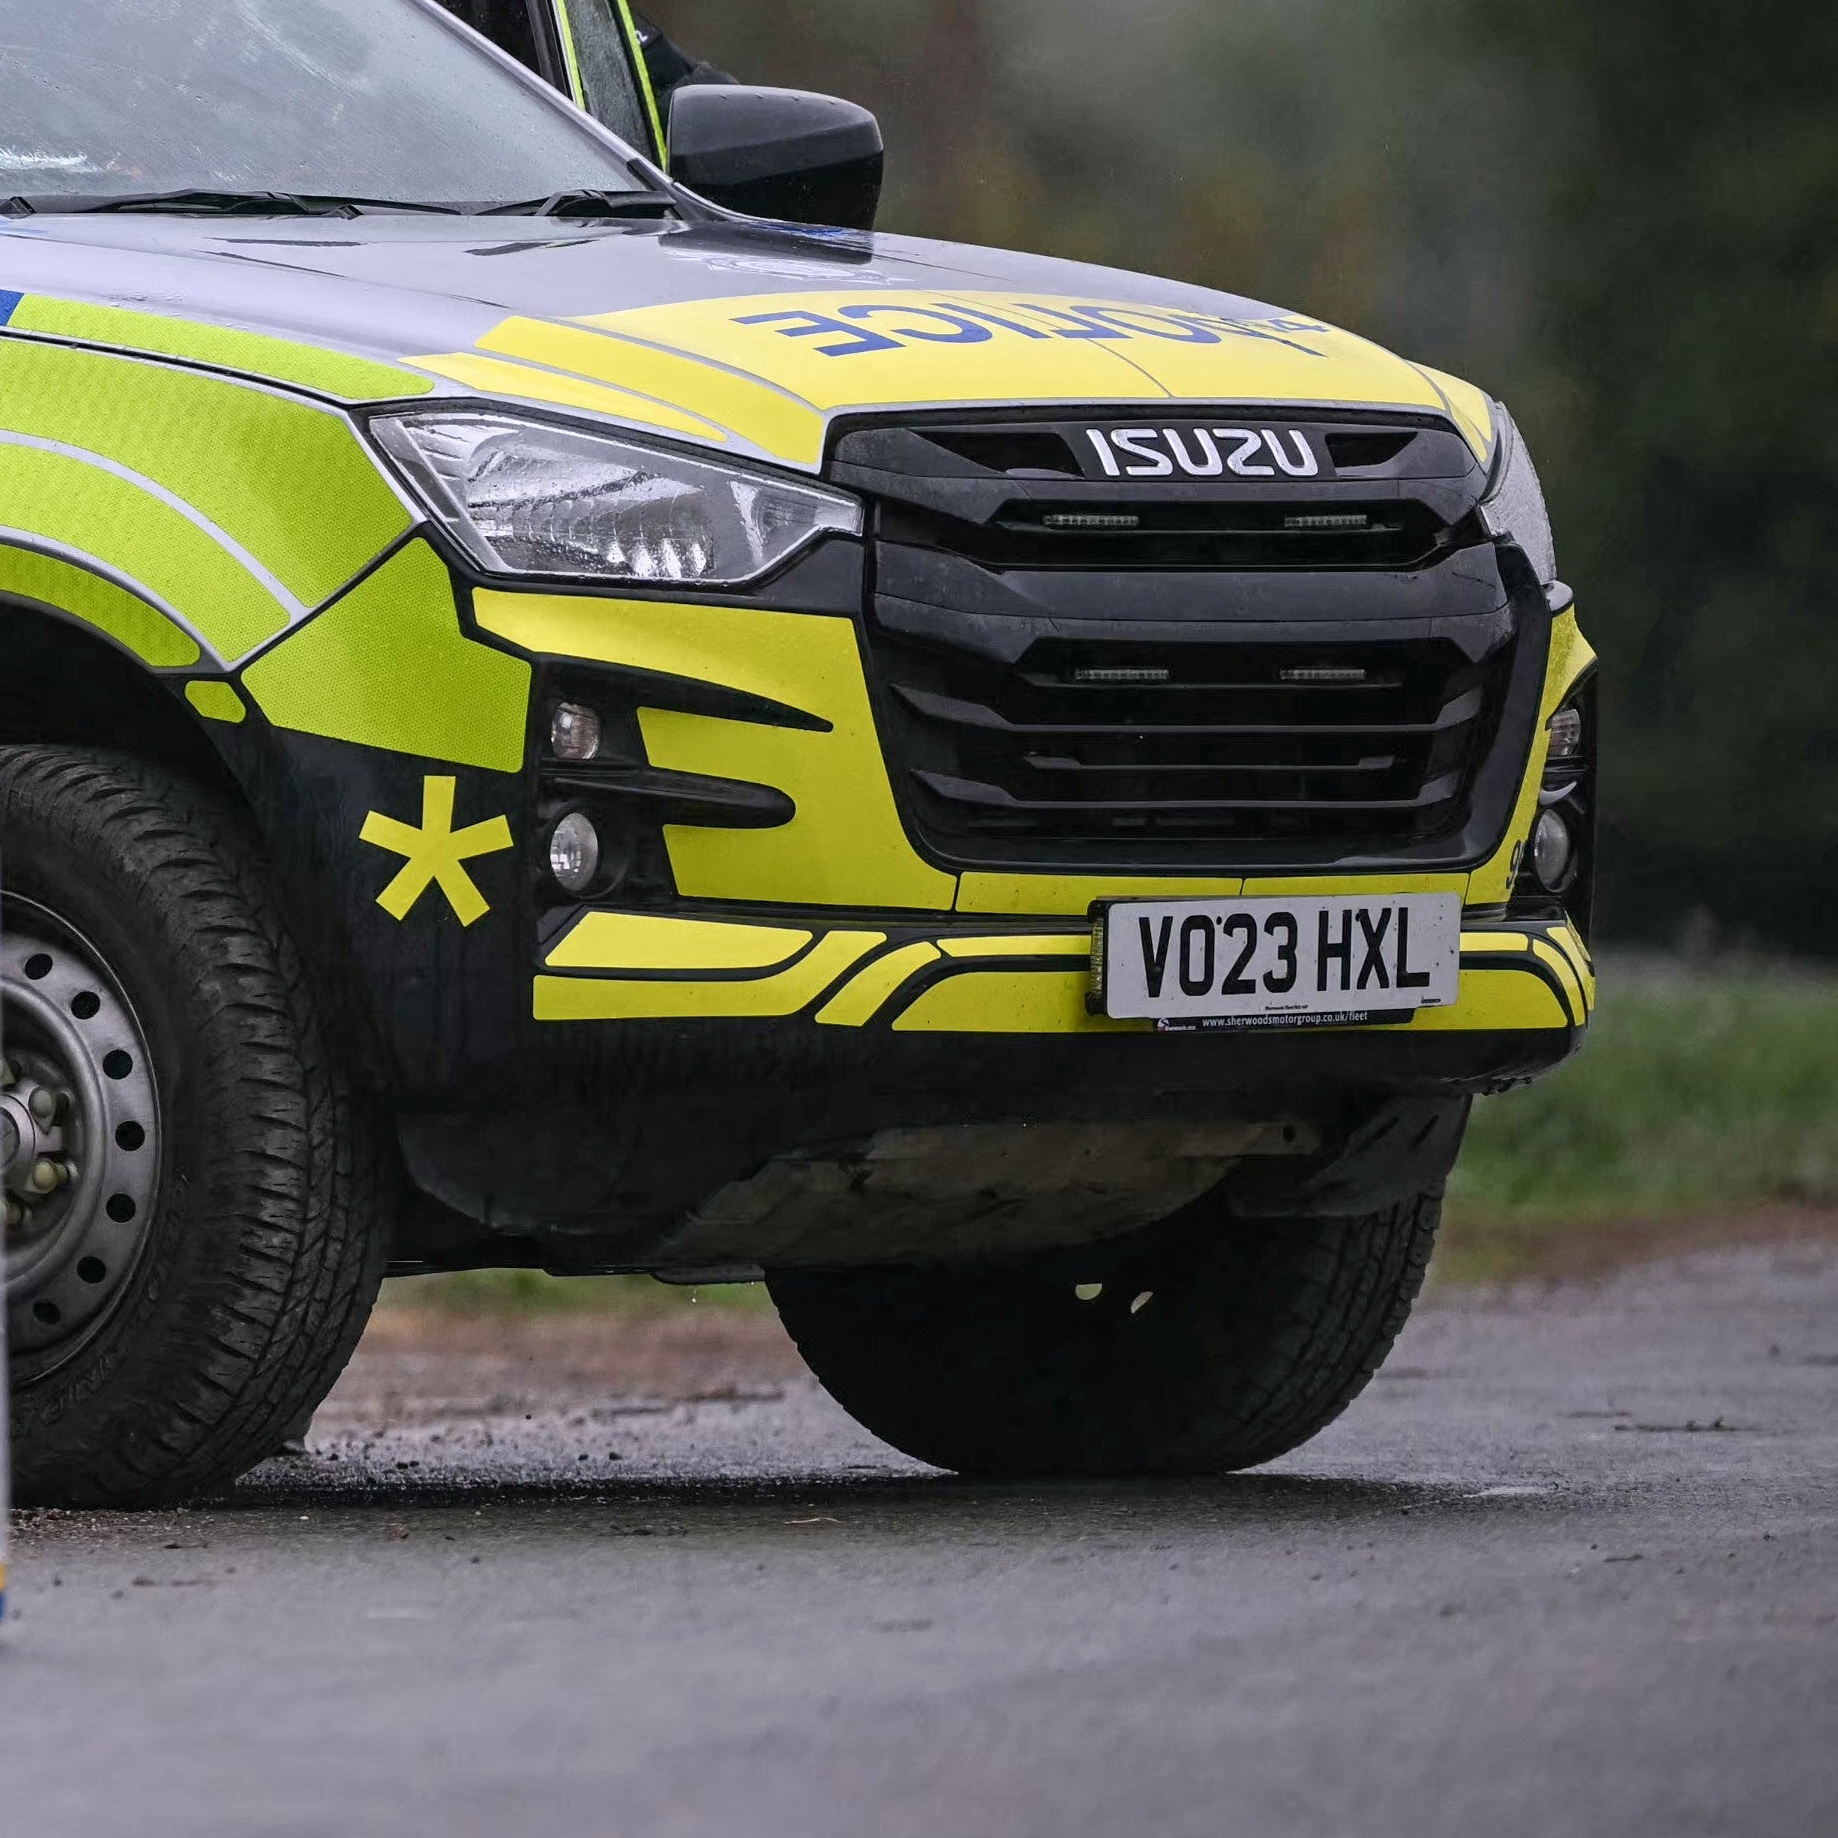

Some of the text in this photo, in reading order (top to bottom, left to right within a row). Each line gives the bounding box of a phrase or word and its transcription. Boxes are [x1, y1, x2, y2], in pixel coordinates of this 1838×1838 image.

[1085, 427, 1319, 478] ISUZU
[1138, 906, 1431, 999] VO23 HXL
[1202, 1010, 1369, 1030] www.sherwoodsmotorgroup.co.uk/fleet
